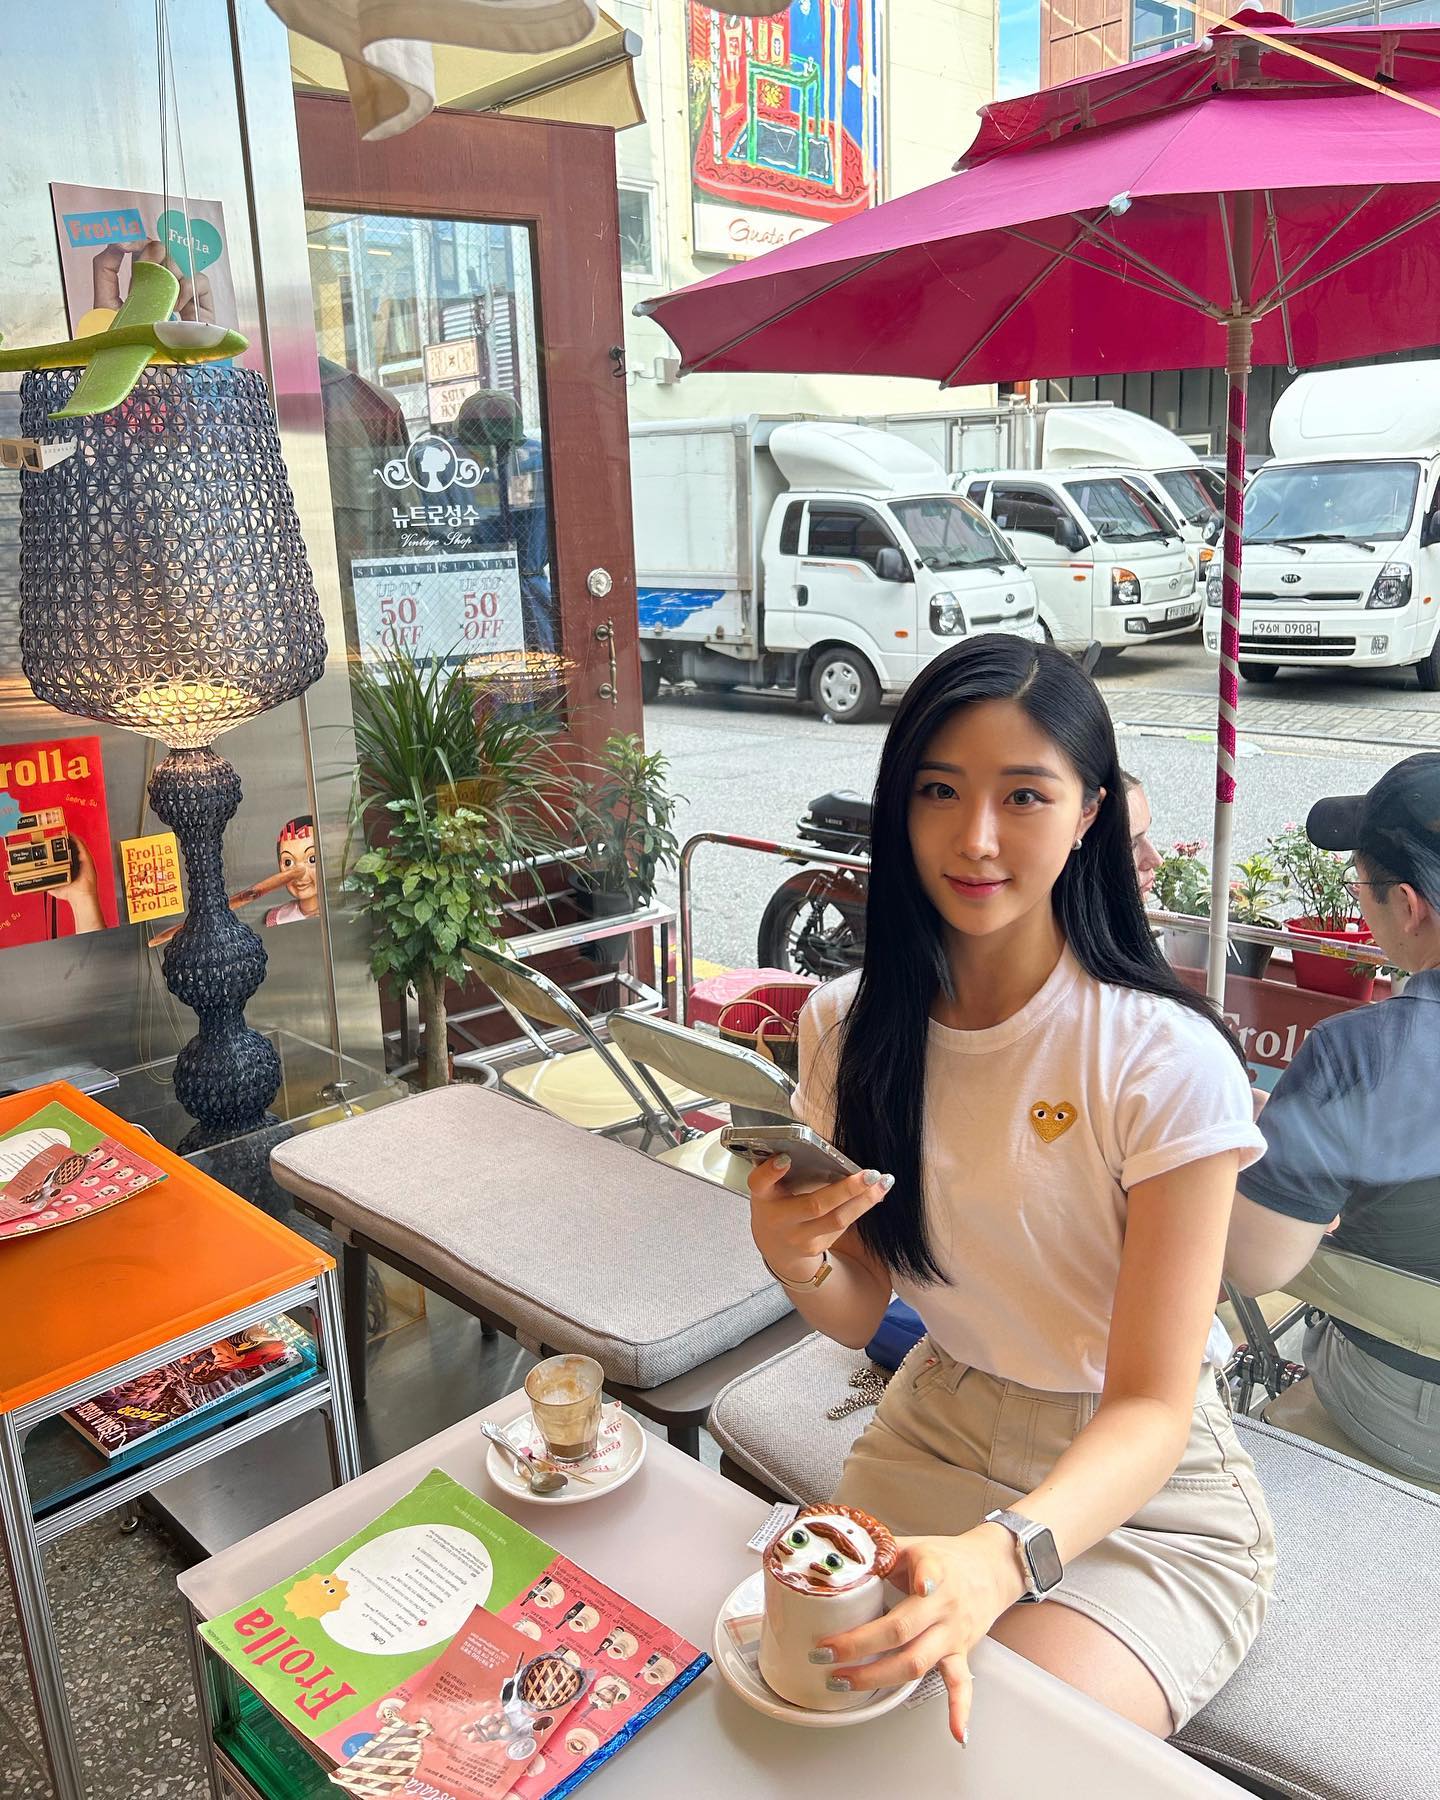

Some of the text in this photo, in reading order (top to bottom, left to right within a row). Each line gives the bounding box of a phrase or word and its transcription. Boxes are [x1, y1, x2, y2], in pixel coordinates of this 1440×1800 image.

[168, 229, 209, 254] Frolla
[391, 504, 480, 529] 뉴트로성수
[401, 531, 473, 551] Vintage Shop
[357, 563, 433, 576] SUMMER
[441, 559, 513, 572] SUMMER
[1282, 574, 1300, 583] KIA
[380, 597, 417, 626] 50
[463, 592, 498, 620] 50
[381, 625, 423, 648] OFF
[464, 619, 504, 641] OFF
[1284, 623, 1313, 635] 0908
[126, 844, 173, 861] Frolla
[128, 857, 175, 875] Frolla
[129, 870, 176, 888] Frolla
[130, 882, 178, 900] Frolla
[131, 896, 179, 914] Frolla
[116, 1405, 168, 1422] ZAGOR
[591, 1440, 621, 1460] Frolla
[370, 1632, 386, 1645] Coffee
[234, 1607, 357, 1720] Frolla
